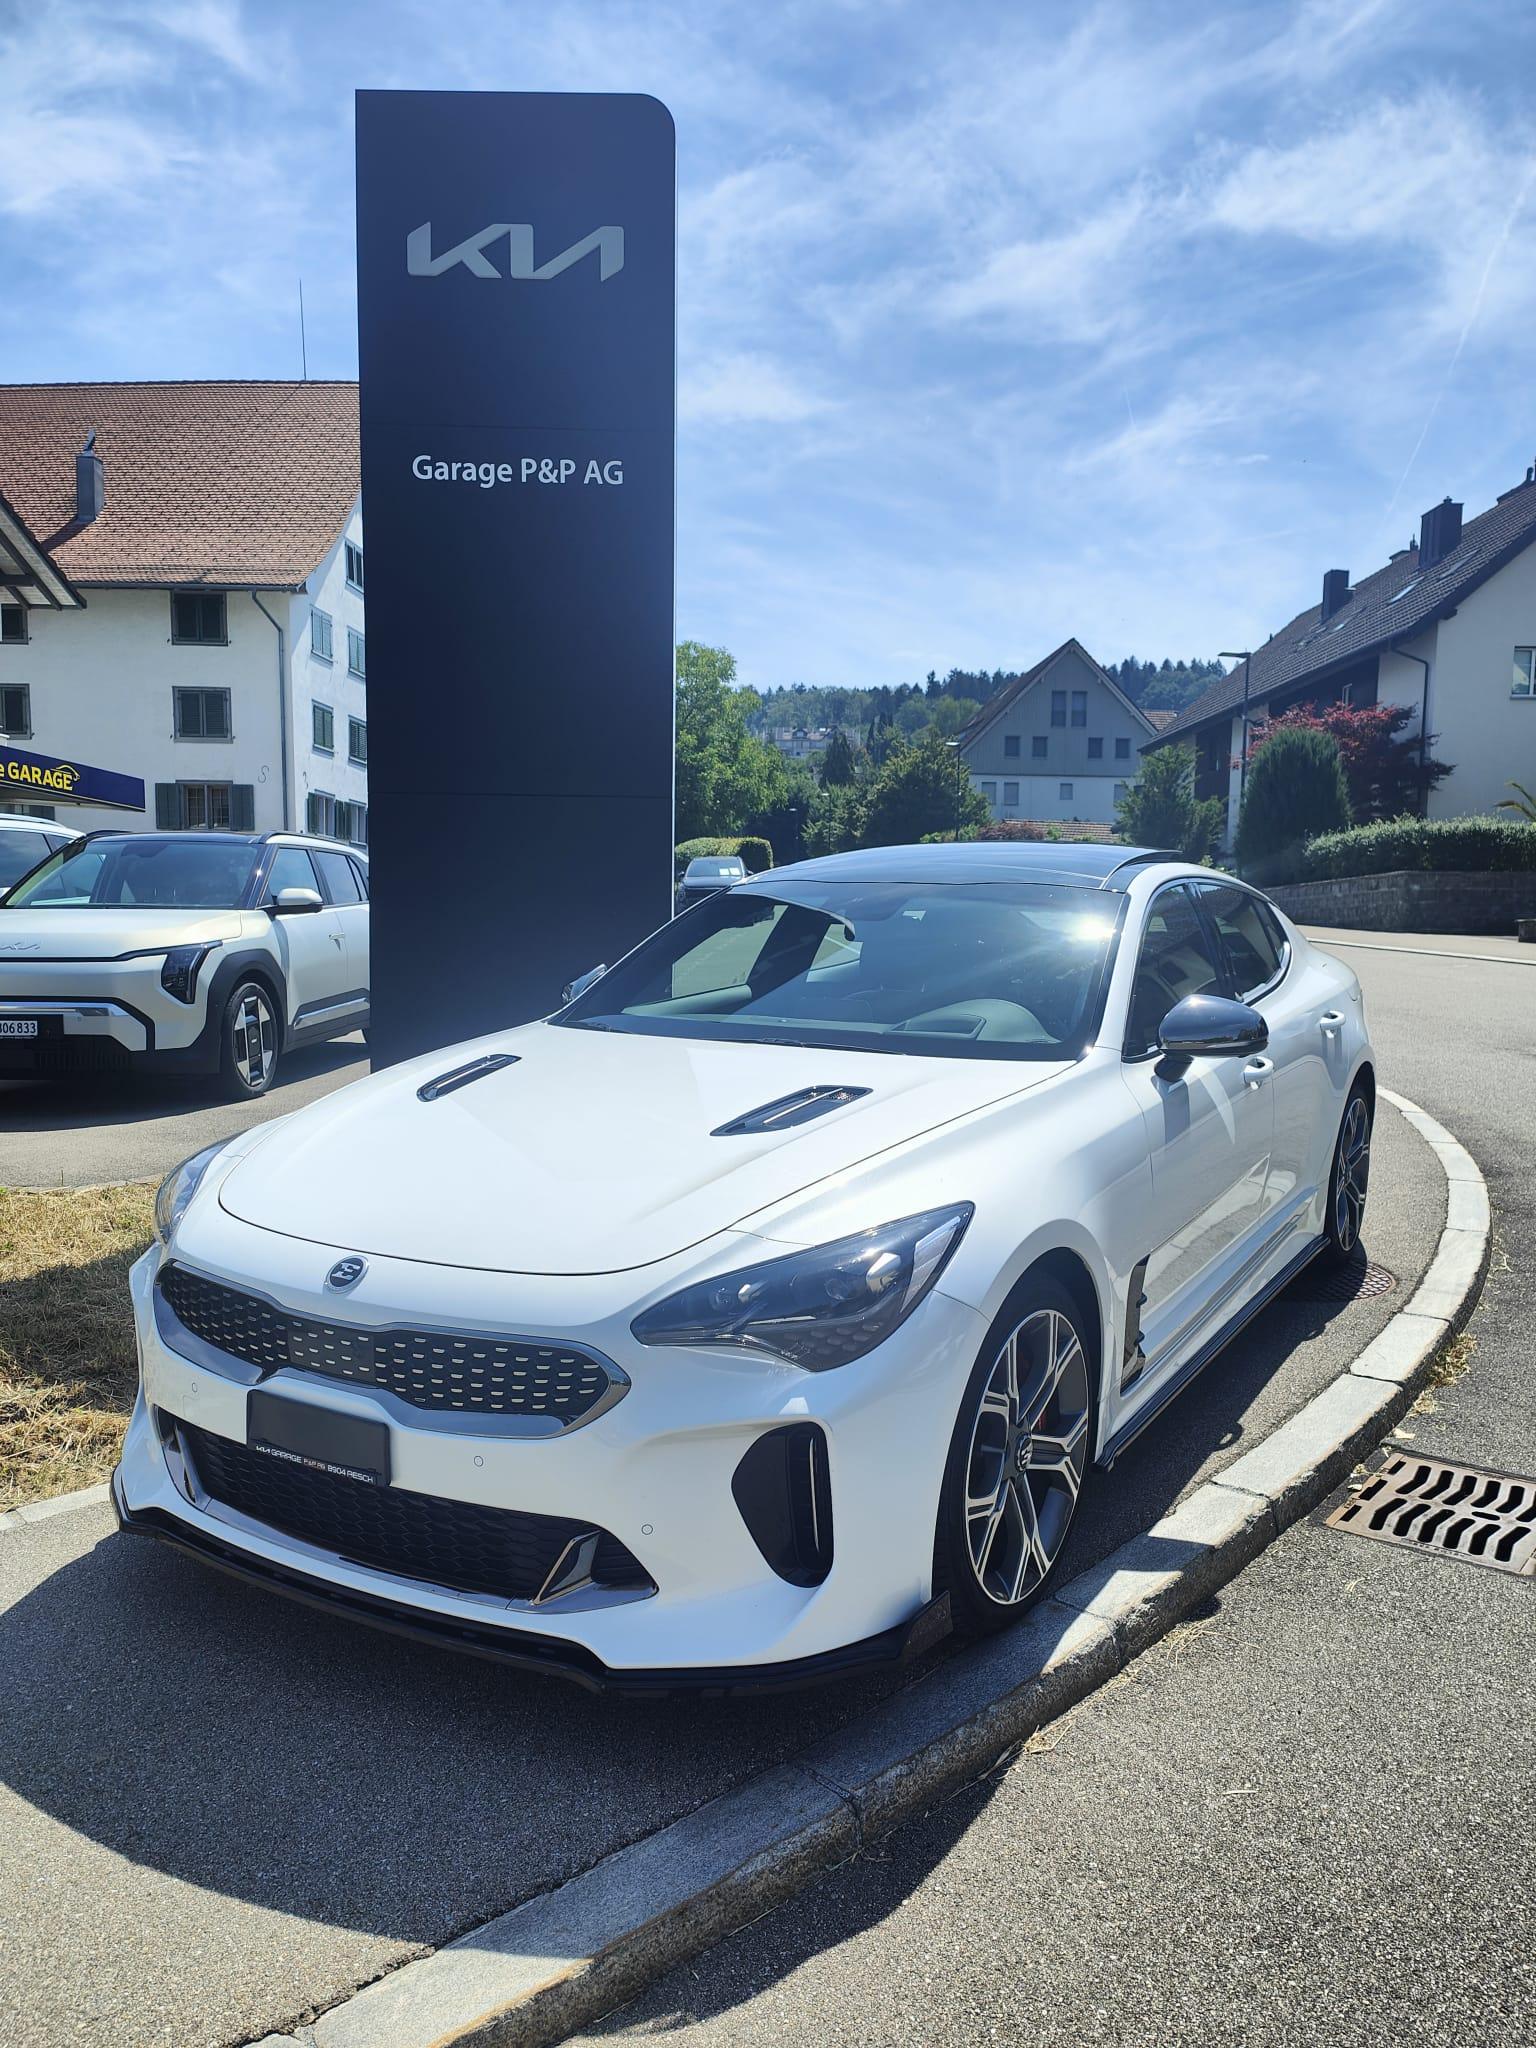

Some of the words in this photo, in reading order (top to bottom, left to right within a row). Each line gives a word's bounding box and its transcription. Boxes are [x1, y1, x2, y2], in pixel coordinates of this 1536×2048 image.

[406, 221, 625, 282] KIA
[412, 455, 513, 489] Garage
[520, 458, 576, 483] P&P
[583, 460, 624, 485] AG
[8, 762, 73, 791] GARAGE
[271, 1449, 302, 1464] GARAGE
